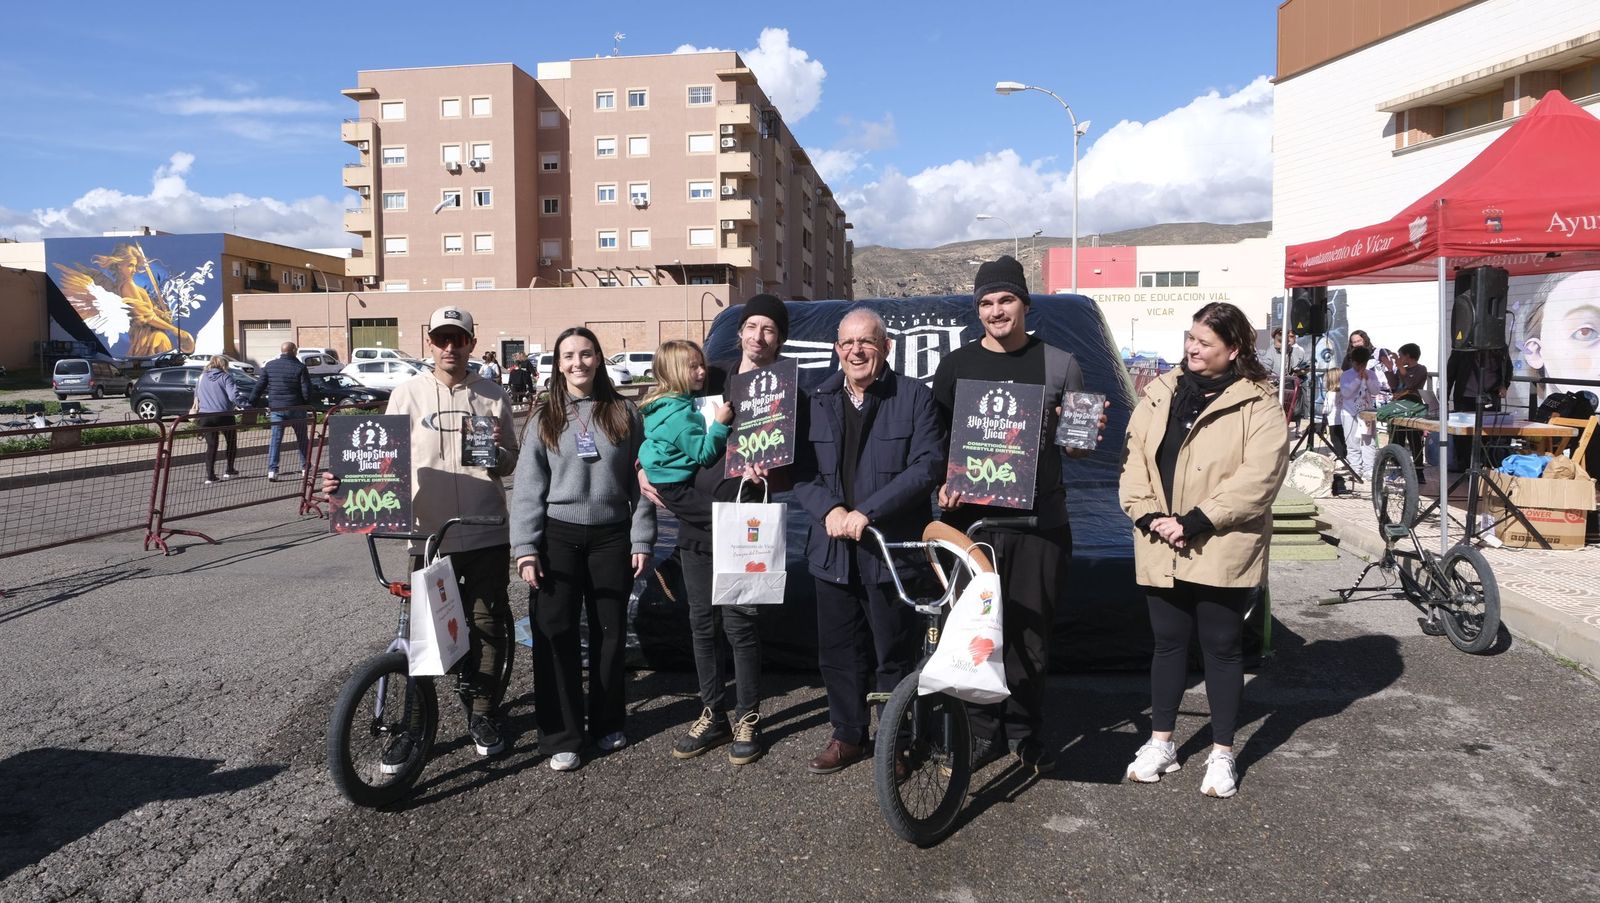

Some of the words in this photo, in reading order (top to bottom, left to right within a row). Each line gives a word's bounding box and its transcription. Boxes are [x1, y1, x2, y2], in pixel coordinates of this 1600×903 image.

[1545, 211, 1600, 237] Ayu
[1351, 239, 1363, 256] de
[1366, 234, 1394, 253] Vícar
[1092, 294, 1130, 303] CENTRO
[1134, 293, 1146, 302] DE
[1150, 292, 1205, 302] EDUCACION
[1209, 292, 1230, 301] VIAL
[1147, 308, 1174, 316] VICAR
[888, 317, 957, 327] TYBIKE
[760, 377, 767, 392] 1
[993, 396, 1004, 412] 3
[365, 428, 376, 445] 2
[736, 428, 785, 458] 200€
[962, 445, 994, 453] FREESTYLE
[965, 456, 1016, 485] 50€
[343, 488, 401, 516] 100€
[1522, 510, 1552, 518] OWER
